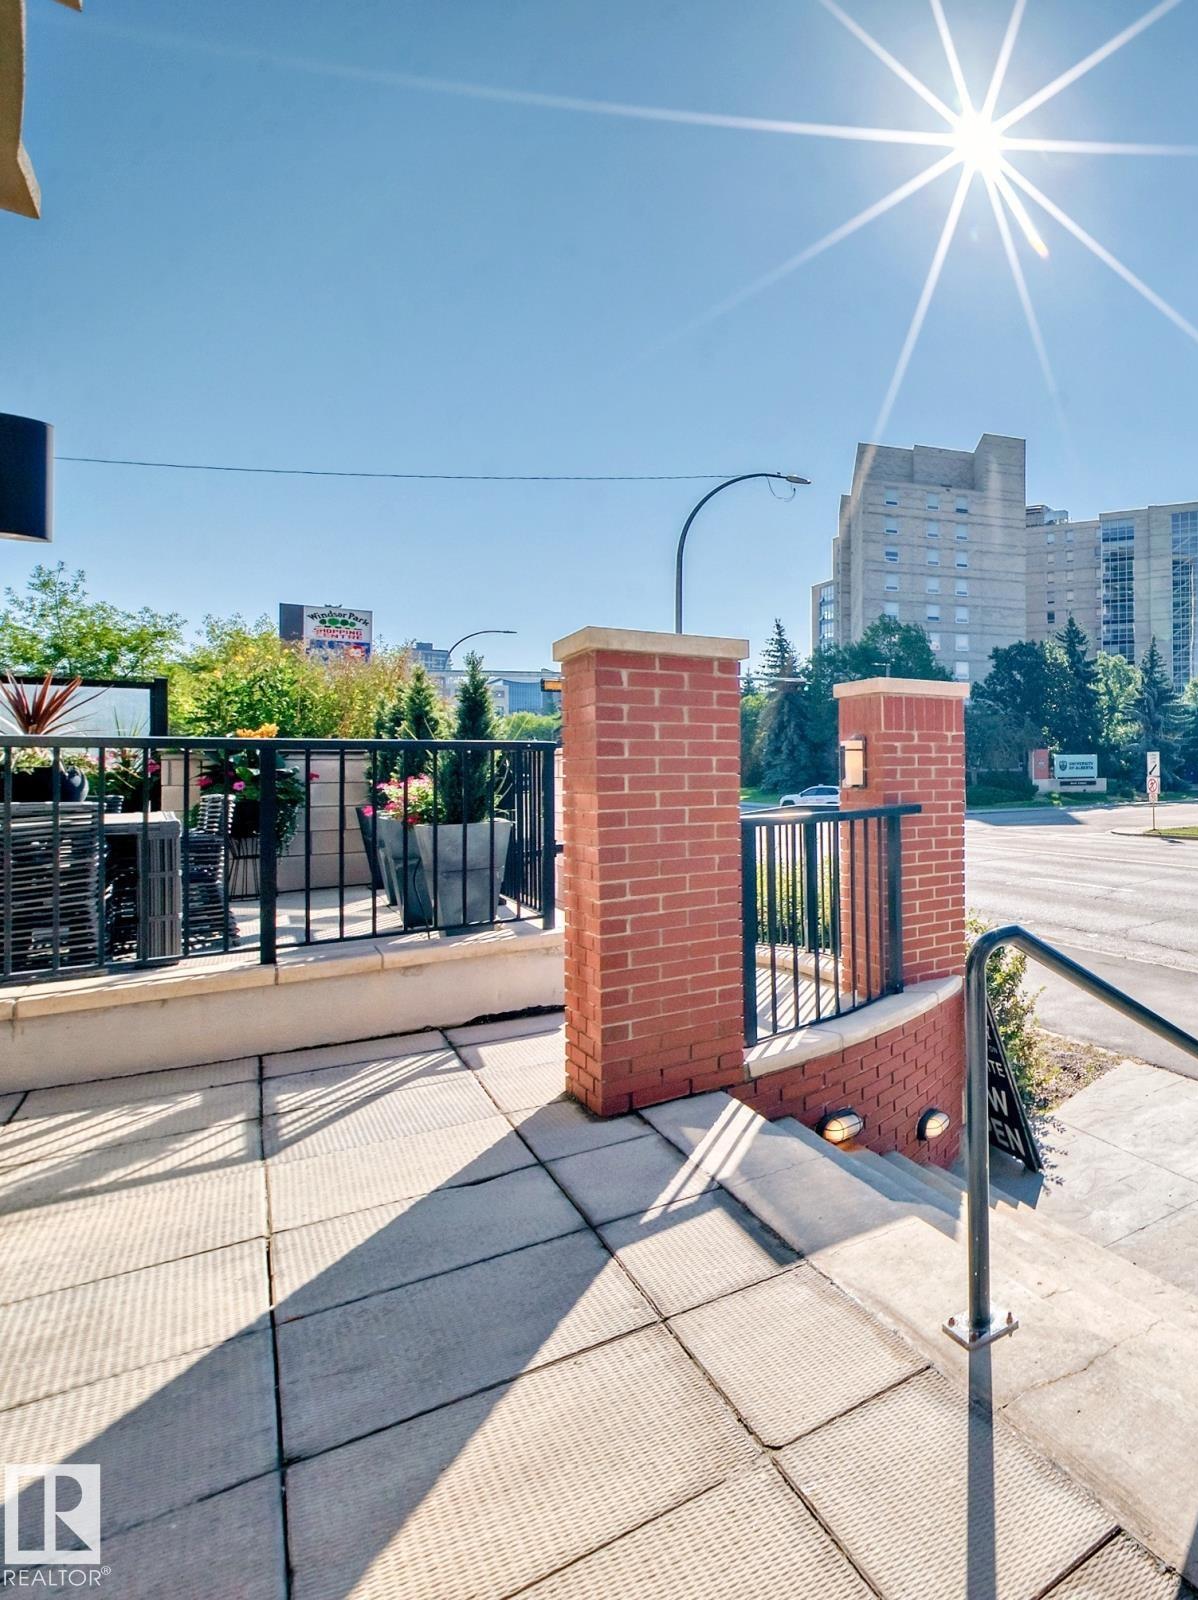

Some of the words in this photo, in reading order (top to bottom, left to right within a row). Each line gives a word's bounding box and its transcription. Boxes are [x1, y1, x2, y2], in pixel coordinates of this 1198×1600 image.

[306, 610, 348, 621] Windsor
[348, 612, 370, 627] Park
[988, 1116, 1026, 1157] EN
